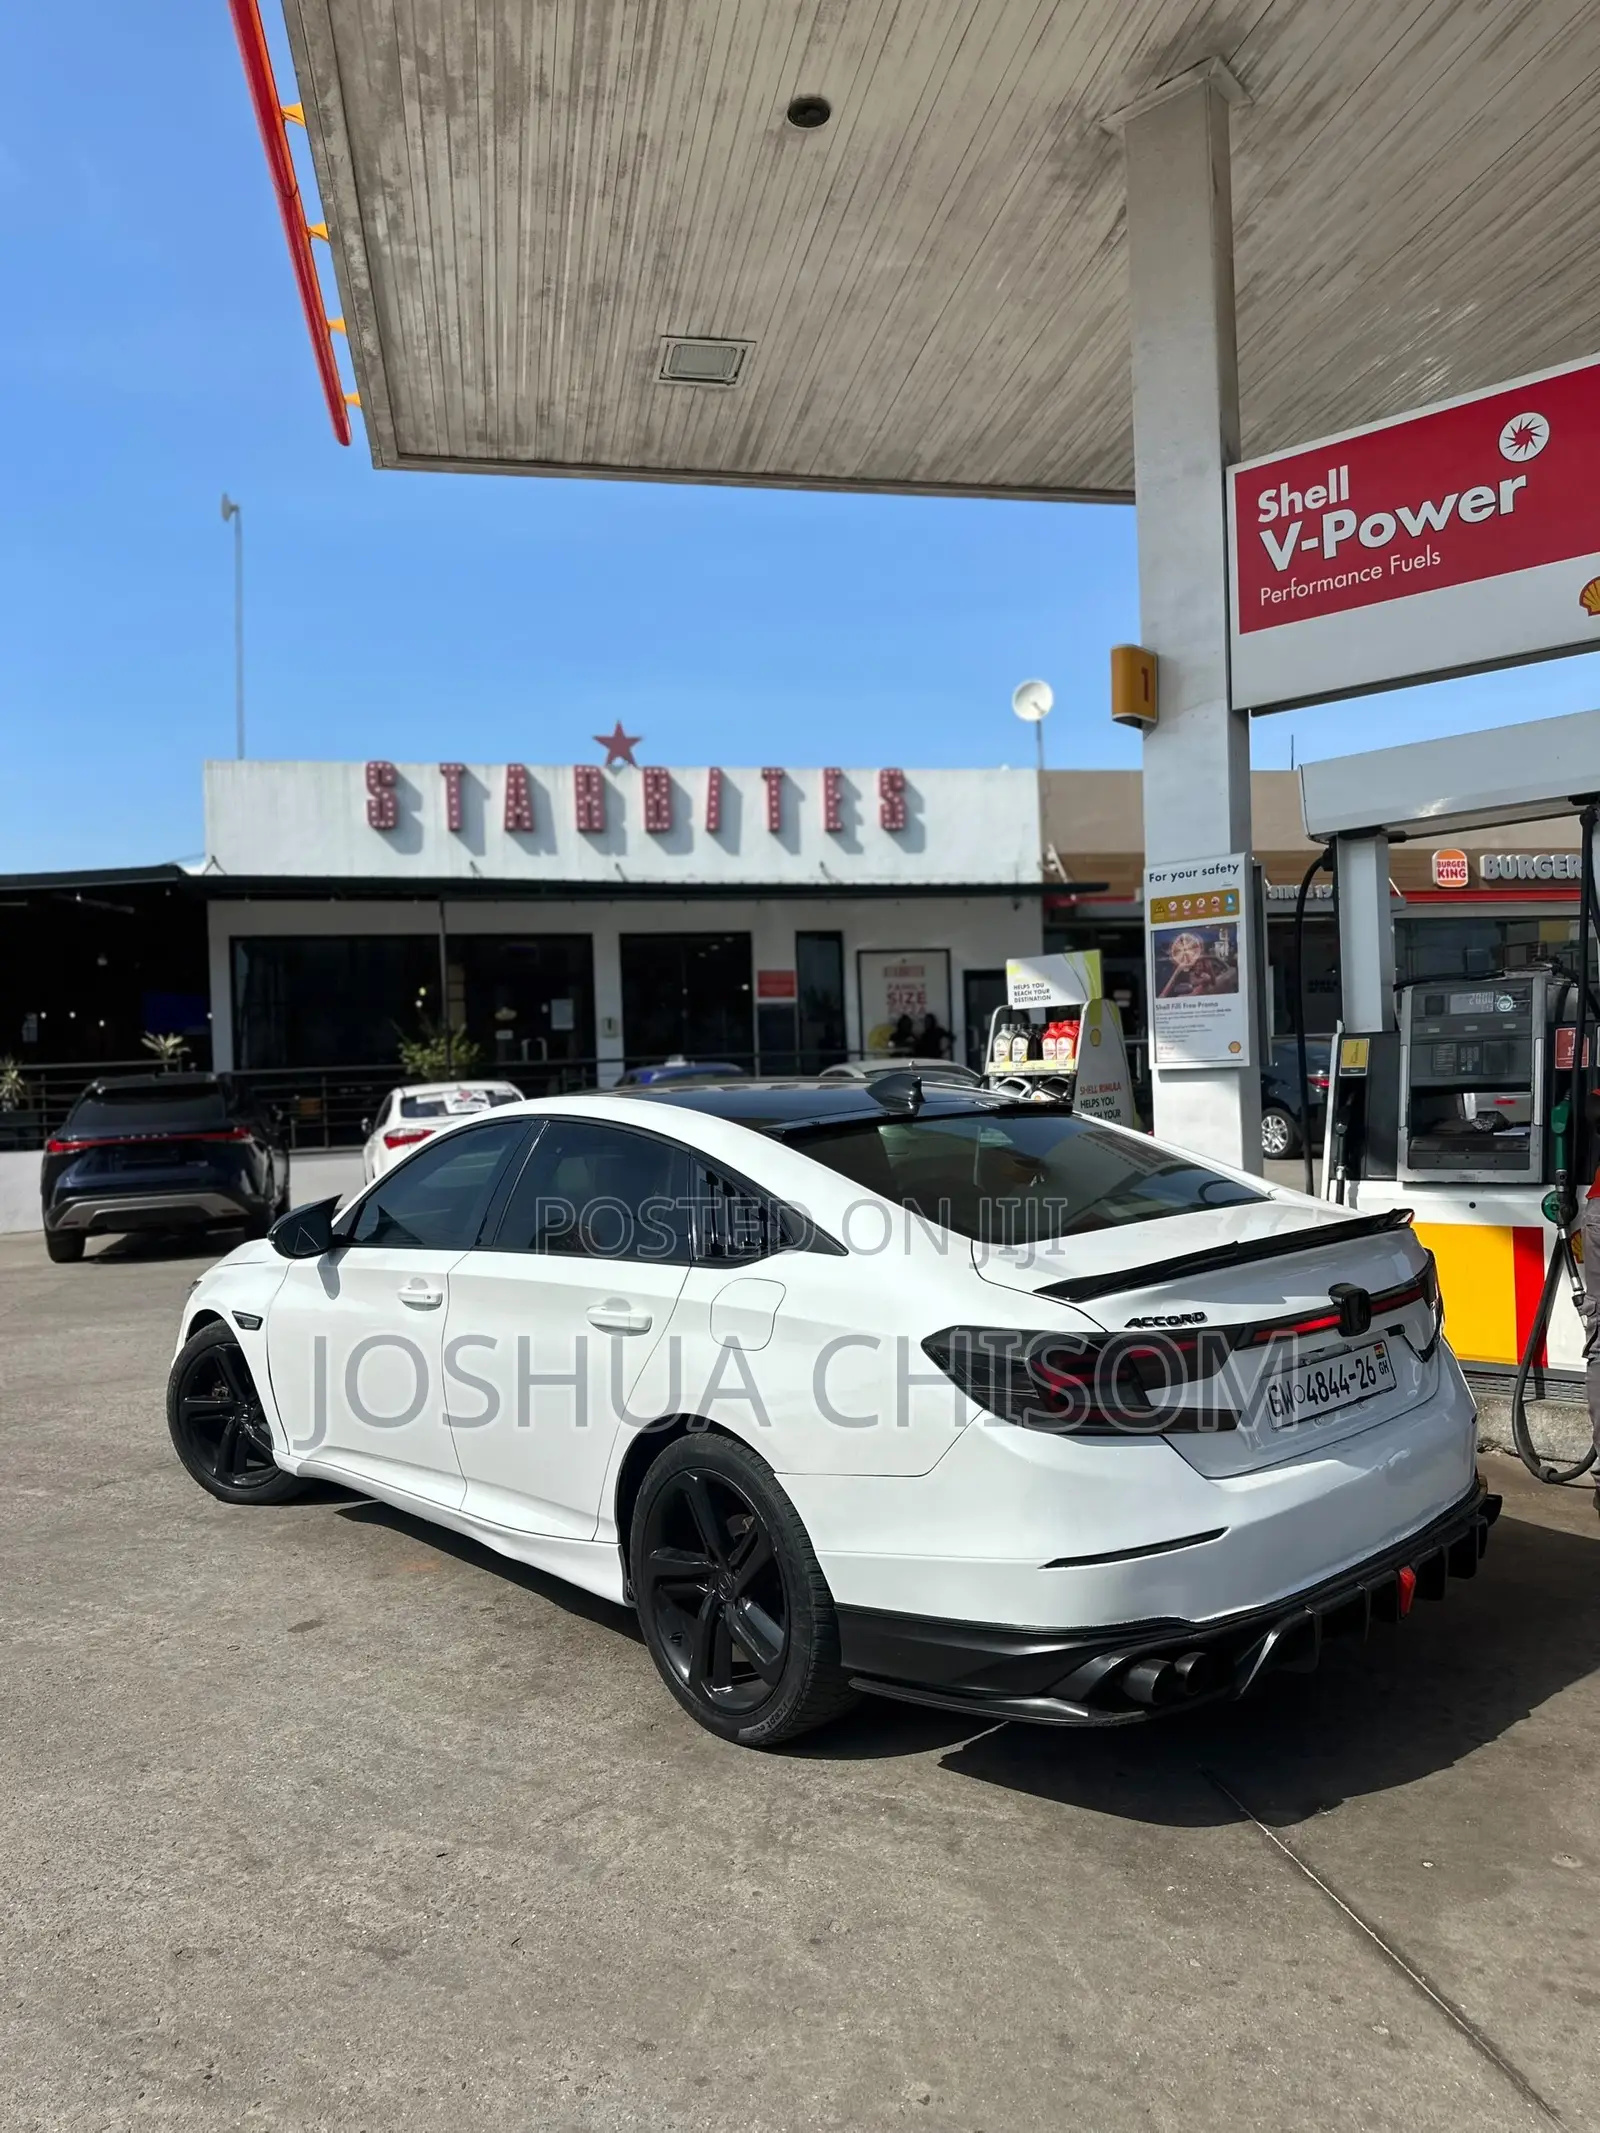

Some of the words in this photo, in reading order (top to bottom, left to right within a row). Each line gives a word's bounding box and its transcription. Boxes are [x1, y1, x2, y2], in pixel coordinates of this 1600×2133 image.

[1257, 465, 1349, 523] Shell
[1259, 475, 1527, 573] V-Power
[1260, 565, 1383, 606] Performance
[1390, 545, 1441, 576] Fuels
[1141, 666, 1149, 703] 1
[366, 761, 904, 833] STARBITES
[1437, 860, 1466, 868] BURGER
[1481, 854, 1581, 880] BURGER
[1149, 873, 1167, 882] For
[1171, 869, 1198, 882] your
[1202, 863, 1239, 876] safety
[1437, 868, 1467, 879] KING
[887, 991, 927, 1005] SIZE
[1014, 994, 1052, 1003] DESTINATION
[1034, 988, 1050, 996] YOUR
[1155, 1003, 1170, 1011] Shell
[1080, 1098, 1100, 1109] HELPS
[1101, 1096, 1115, 1107] YOU
[1103, 1108, 1122, 1120] YOUR
[1124, 1311, 1207, 1328] ACCORD
[1379, 1360, 1390, 1376] GH
[1268, 1381, 1296, 1418] GW
[1306, 1356, 1377, 1406] 4844-26
